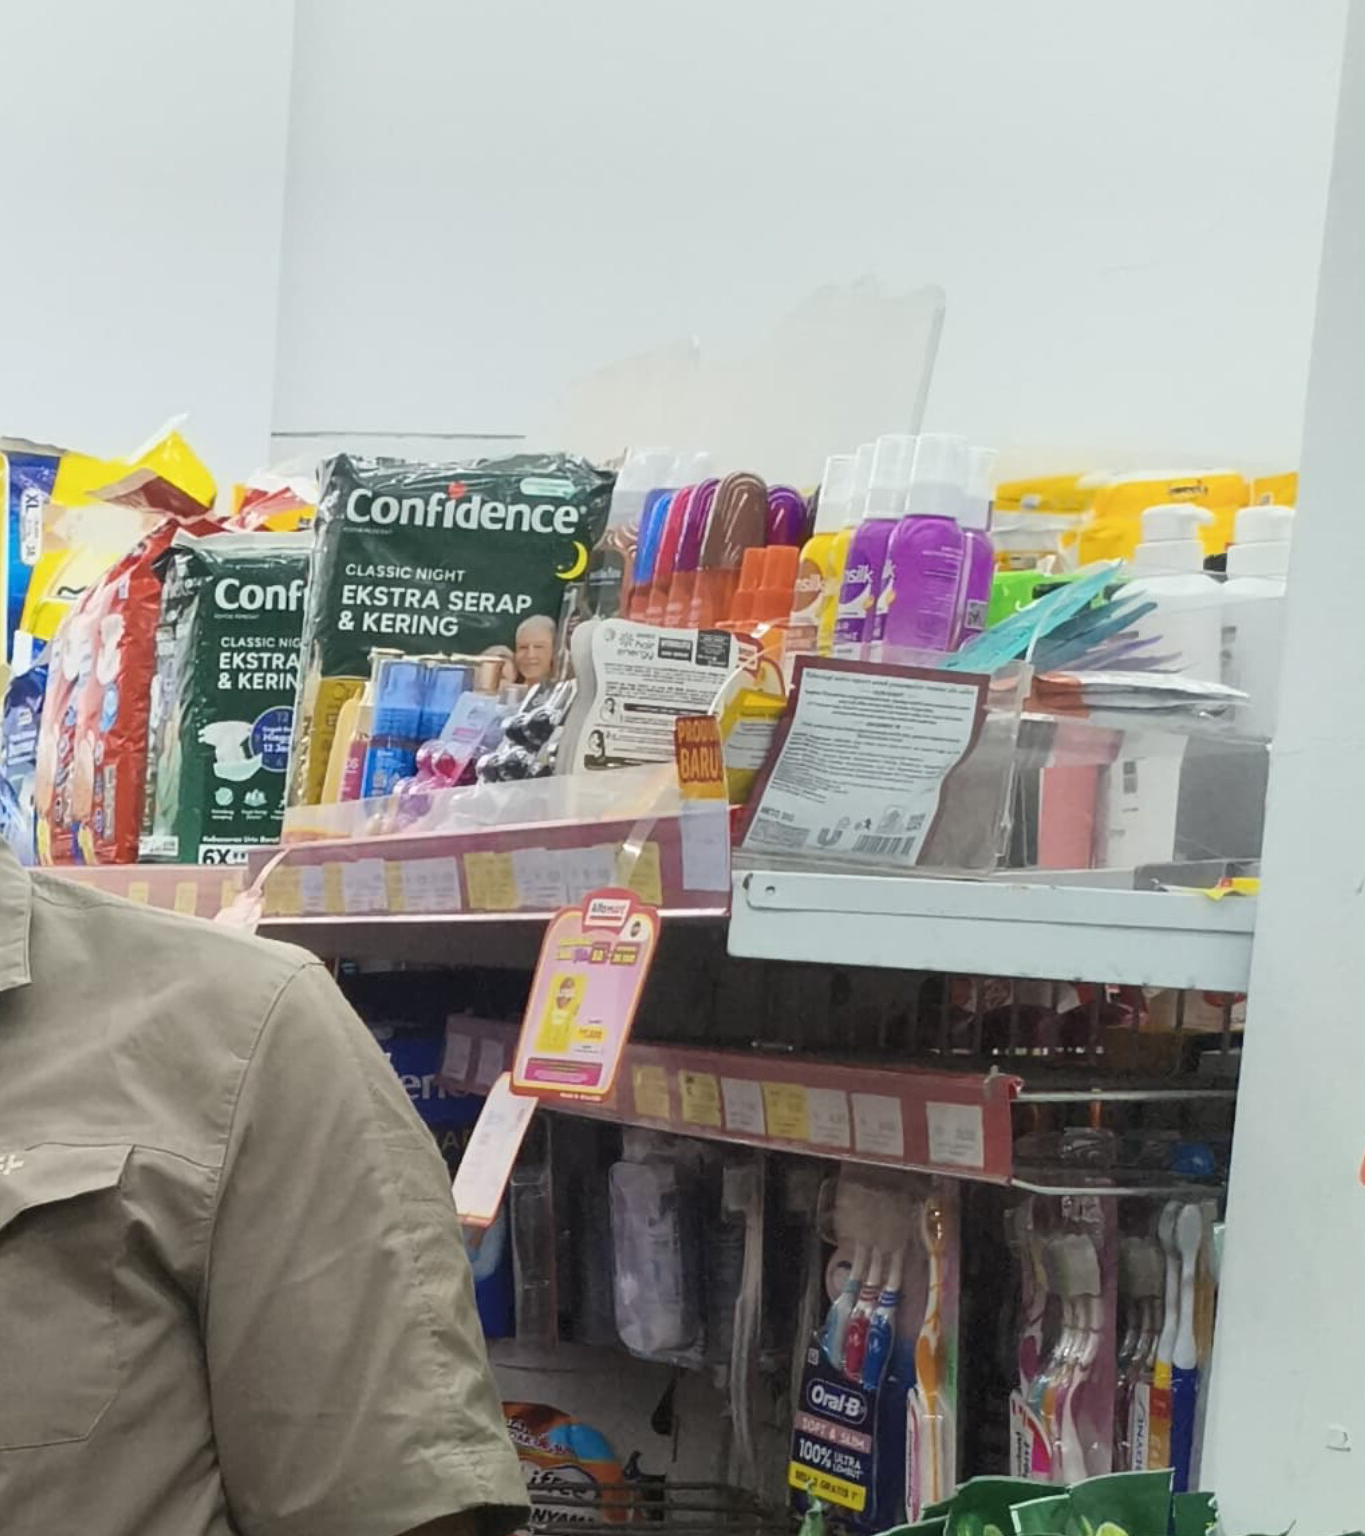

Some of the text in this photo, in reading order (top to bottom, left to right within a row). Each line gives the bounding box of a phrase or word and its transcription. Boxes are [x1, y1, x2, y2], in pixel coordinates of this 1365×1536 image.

[345, 483, 580, 535] Confidence
[345, 563, 466, 584] CLASSIC NIGHT
[341, 584, 533, 615] EKSTRA SERAP
[337, 610, 460, 637] & KERING
[221, 635, 284, 650] CLASSIC
[218, 652, 300, 670] EKSTRA
[217, 672, 300, 690] & KERIN
[679, 748, 721, 781] BARU
[810, 1384, 862, 1418] Oral-B
[799, 1438, 833, 1469] 100%
